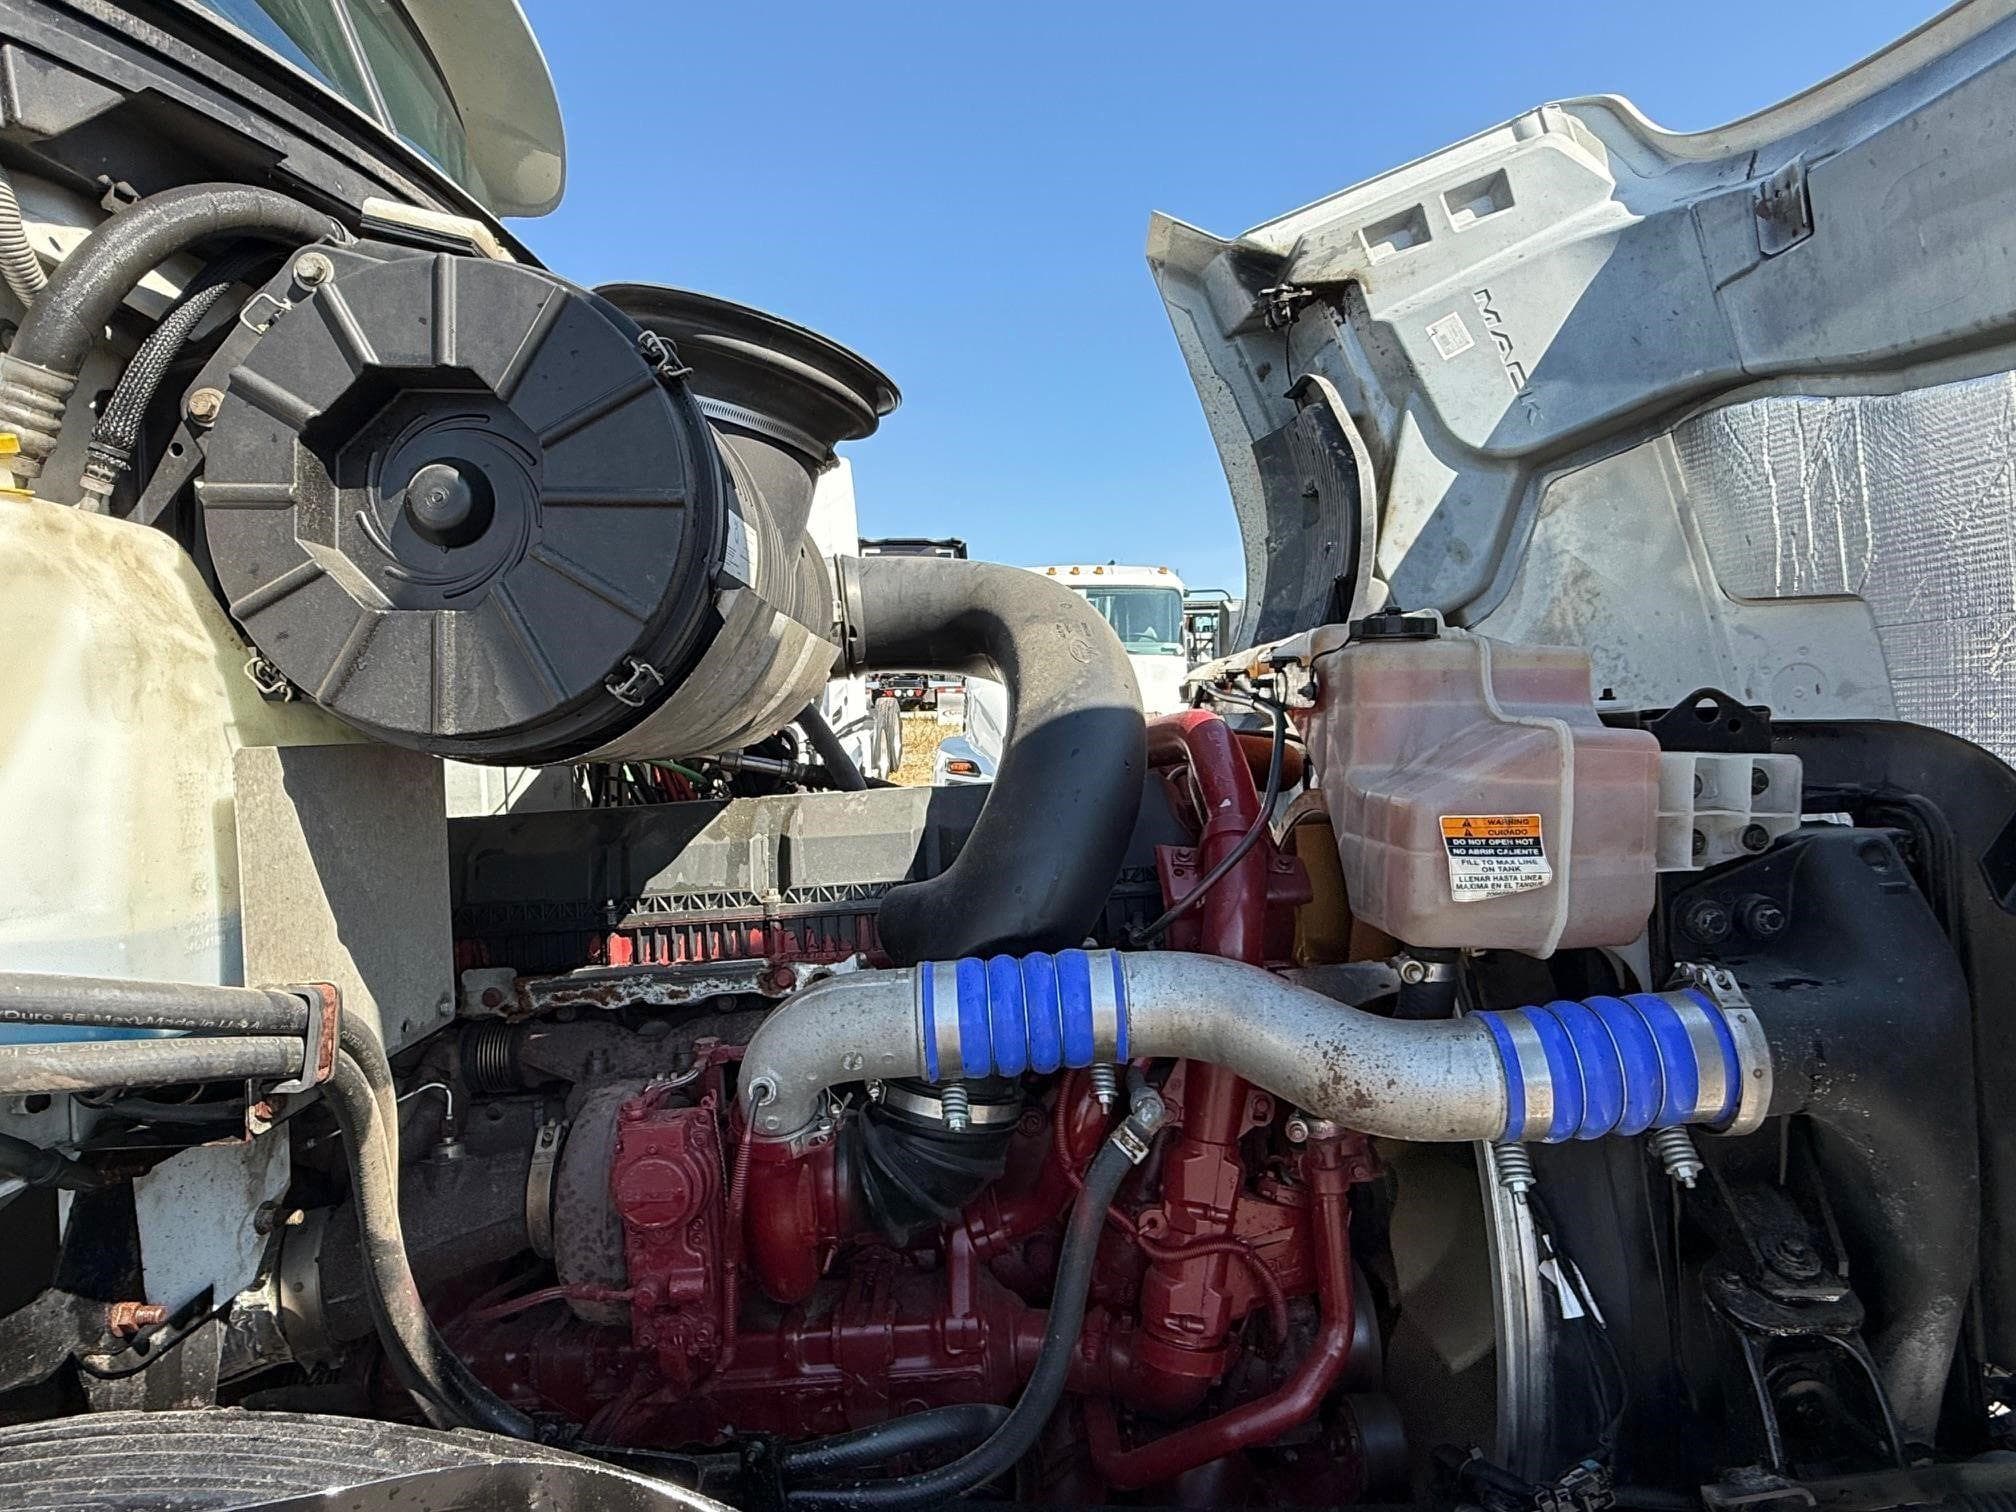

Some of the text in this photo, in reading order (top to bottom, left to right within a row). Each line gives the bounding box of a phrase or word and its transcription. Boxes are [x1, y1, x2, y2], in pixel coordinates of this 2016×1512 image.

[1473, 288, 1543, 428] MACK
[1487, 818, 1530, 826] WARNING
[1452, 838, 1466, 846] DO
[1469, 838, 1487, 846] NOT
[1489, 838, 1514, 846] OPEN
[1458, 875, 1491, 883] LLENAR
[26, 1045, 72, 1055] SAE
